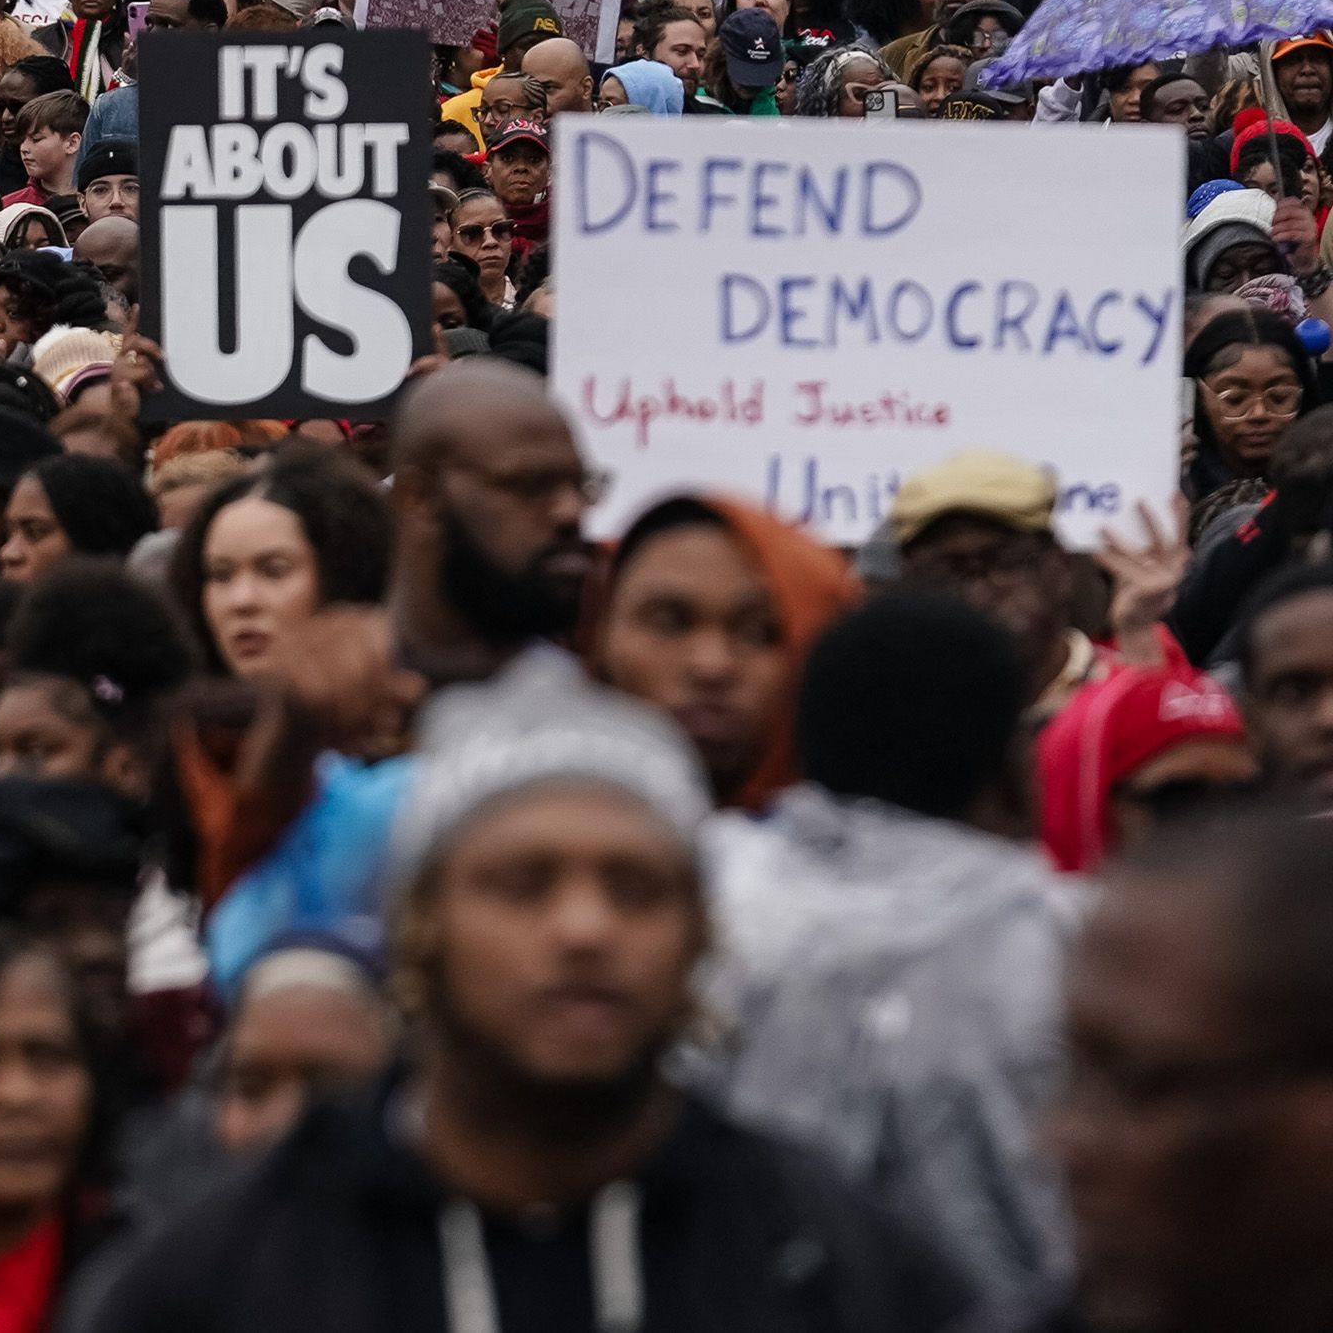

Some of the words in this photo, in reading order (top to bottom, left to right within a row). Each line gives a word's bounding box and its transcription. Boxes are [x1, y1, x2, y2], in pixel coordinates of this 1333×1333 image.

[217, 42, 349, 121] IT'S
[158, 121, 411, 200] ABOUT
[574, 129, 925, 238] DEFEND
[160, 197, 414, 406] US
[718, 272, 1177, 366] DEMOCRACY
[580, 373, 767, 450] Uphold
[794, 377, 955, 430] Justice
